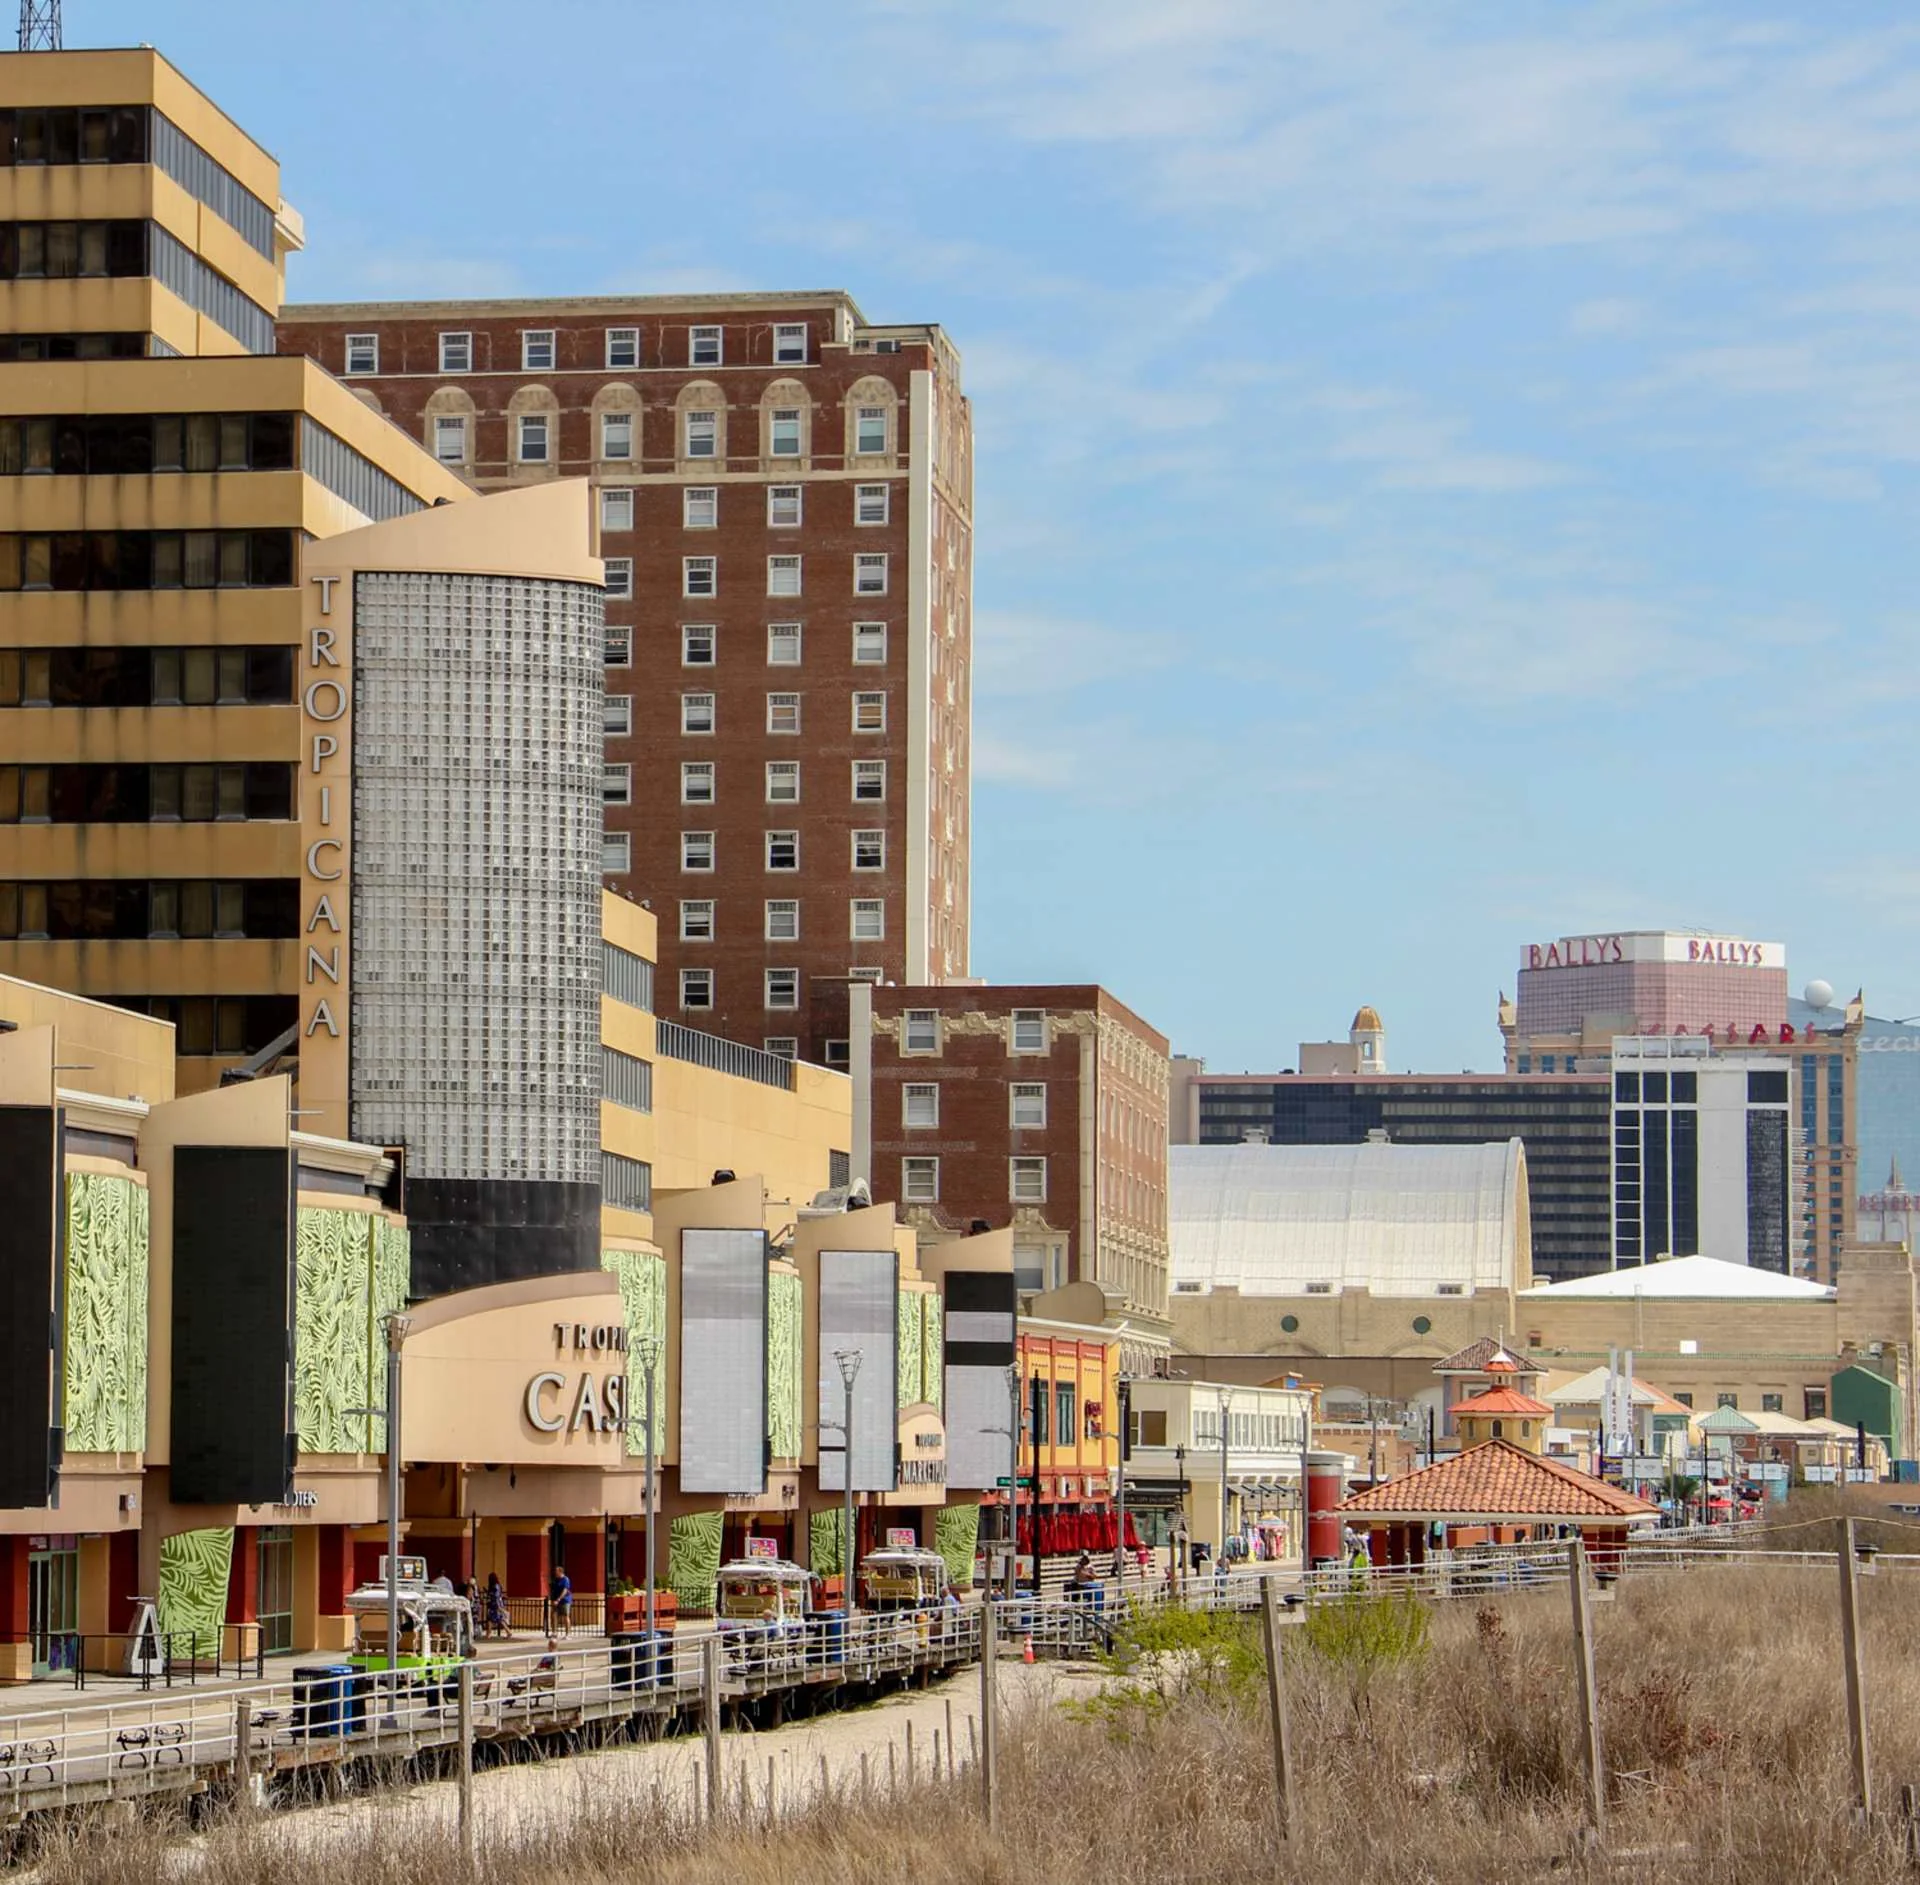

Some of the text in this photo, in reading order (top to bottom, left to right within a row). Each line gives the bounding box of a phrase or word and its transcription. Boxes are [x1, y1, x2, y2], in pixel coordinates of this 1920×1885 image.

[304, 575, 347, 1038] TROPICANA
[1528, 936, 1623, 968] BALLYS
[1688, 940, 1763, 964] BALLYS
